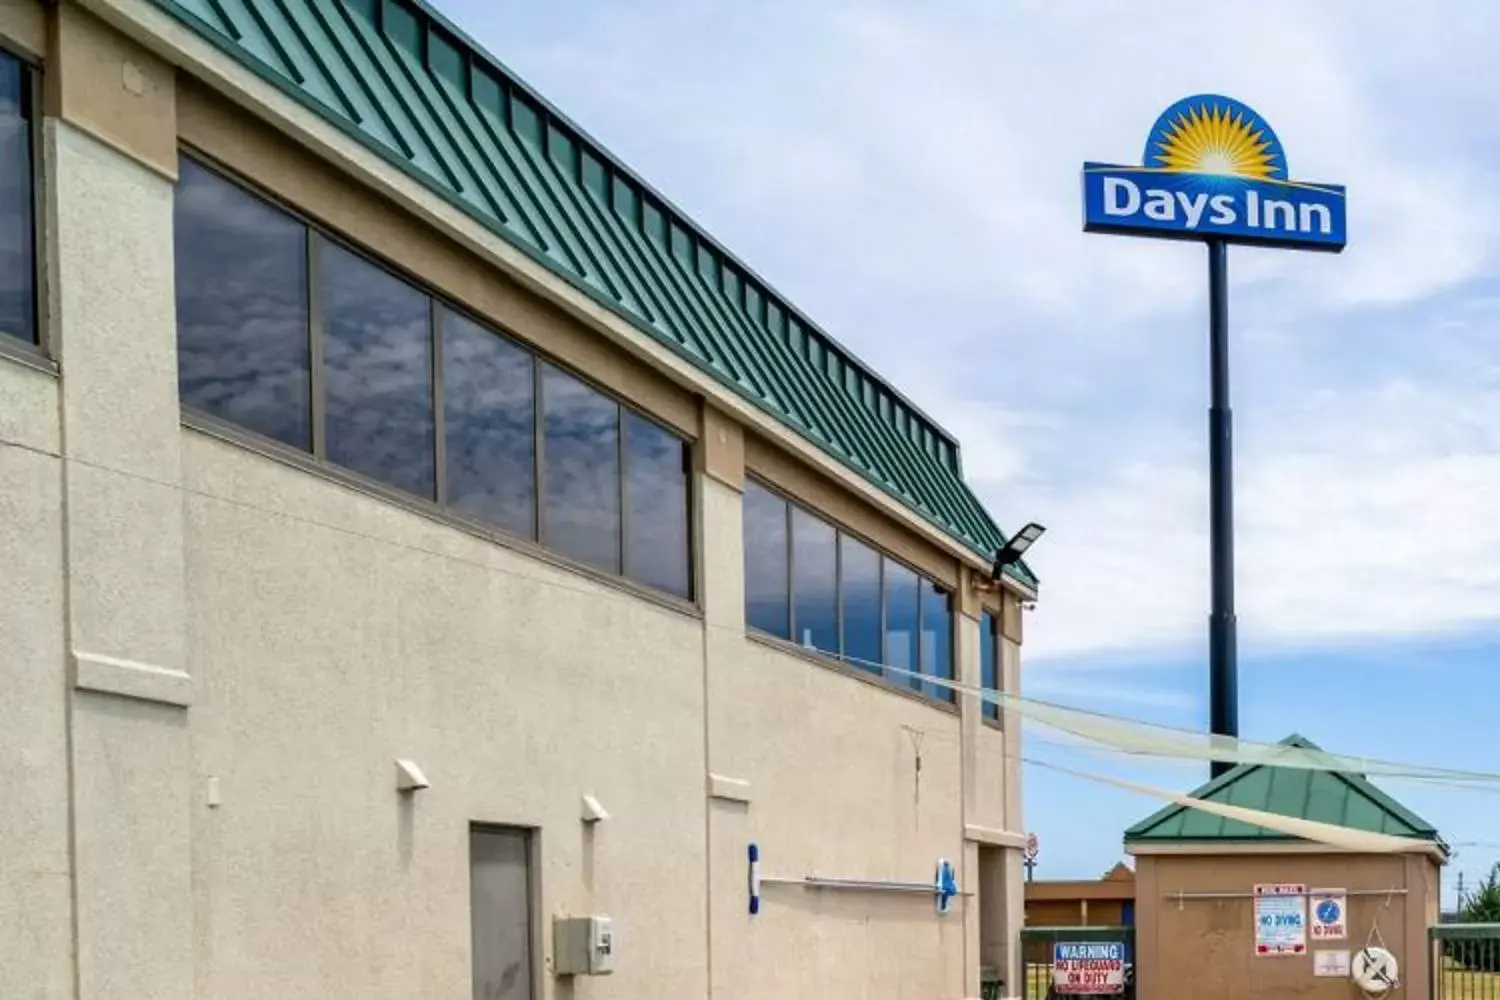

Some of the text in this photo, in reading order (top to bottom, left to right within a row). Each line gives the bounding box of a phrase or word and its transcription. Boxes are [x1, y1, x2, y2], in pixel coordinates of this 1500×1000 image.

[1103, 176, 1331, 234] Days Inn
[1261, 914, 1301, 927] NO DIVING
[1061, 945, 1118, 959] WARNING
[1056, 960, 1120, 971] NO LIFEGUARD
[1068, 972, 1108, 983] ON DUTY
